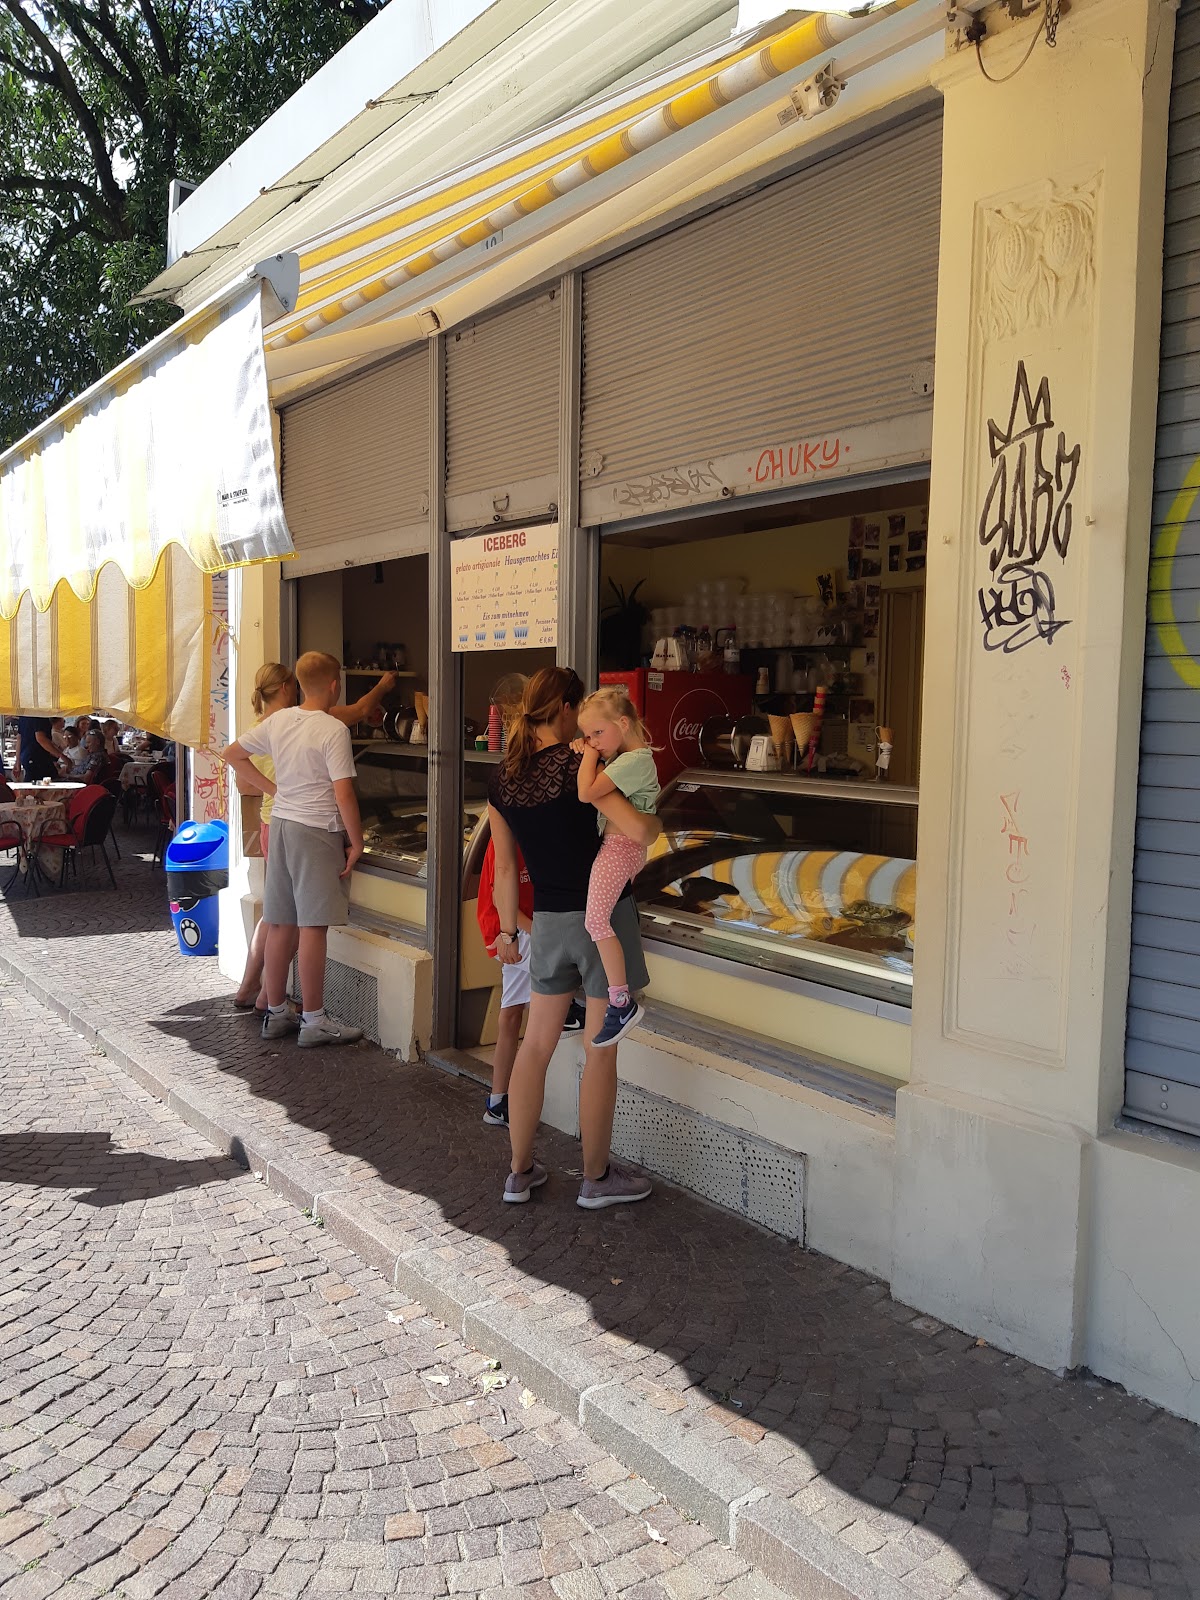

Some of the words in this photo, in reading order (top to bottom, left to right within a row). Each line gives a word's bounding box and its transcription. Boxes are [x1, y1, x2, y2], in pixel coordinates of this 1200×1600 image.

[484, 532, 527, 552] ICEBERG
[455, 562, 472, 575] gelato
[504, 551, 550, 566] Hausgemachtes
[482, 611, 491, 621] Eis
[501, 609, 530, 619] mitnehmen
